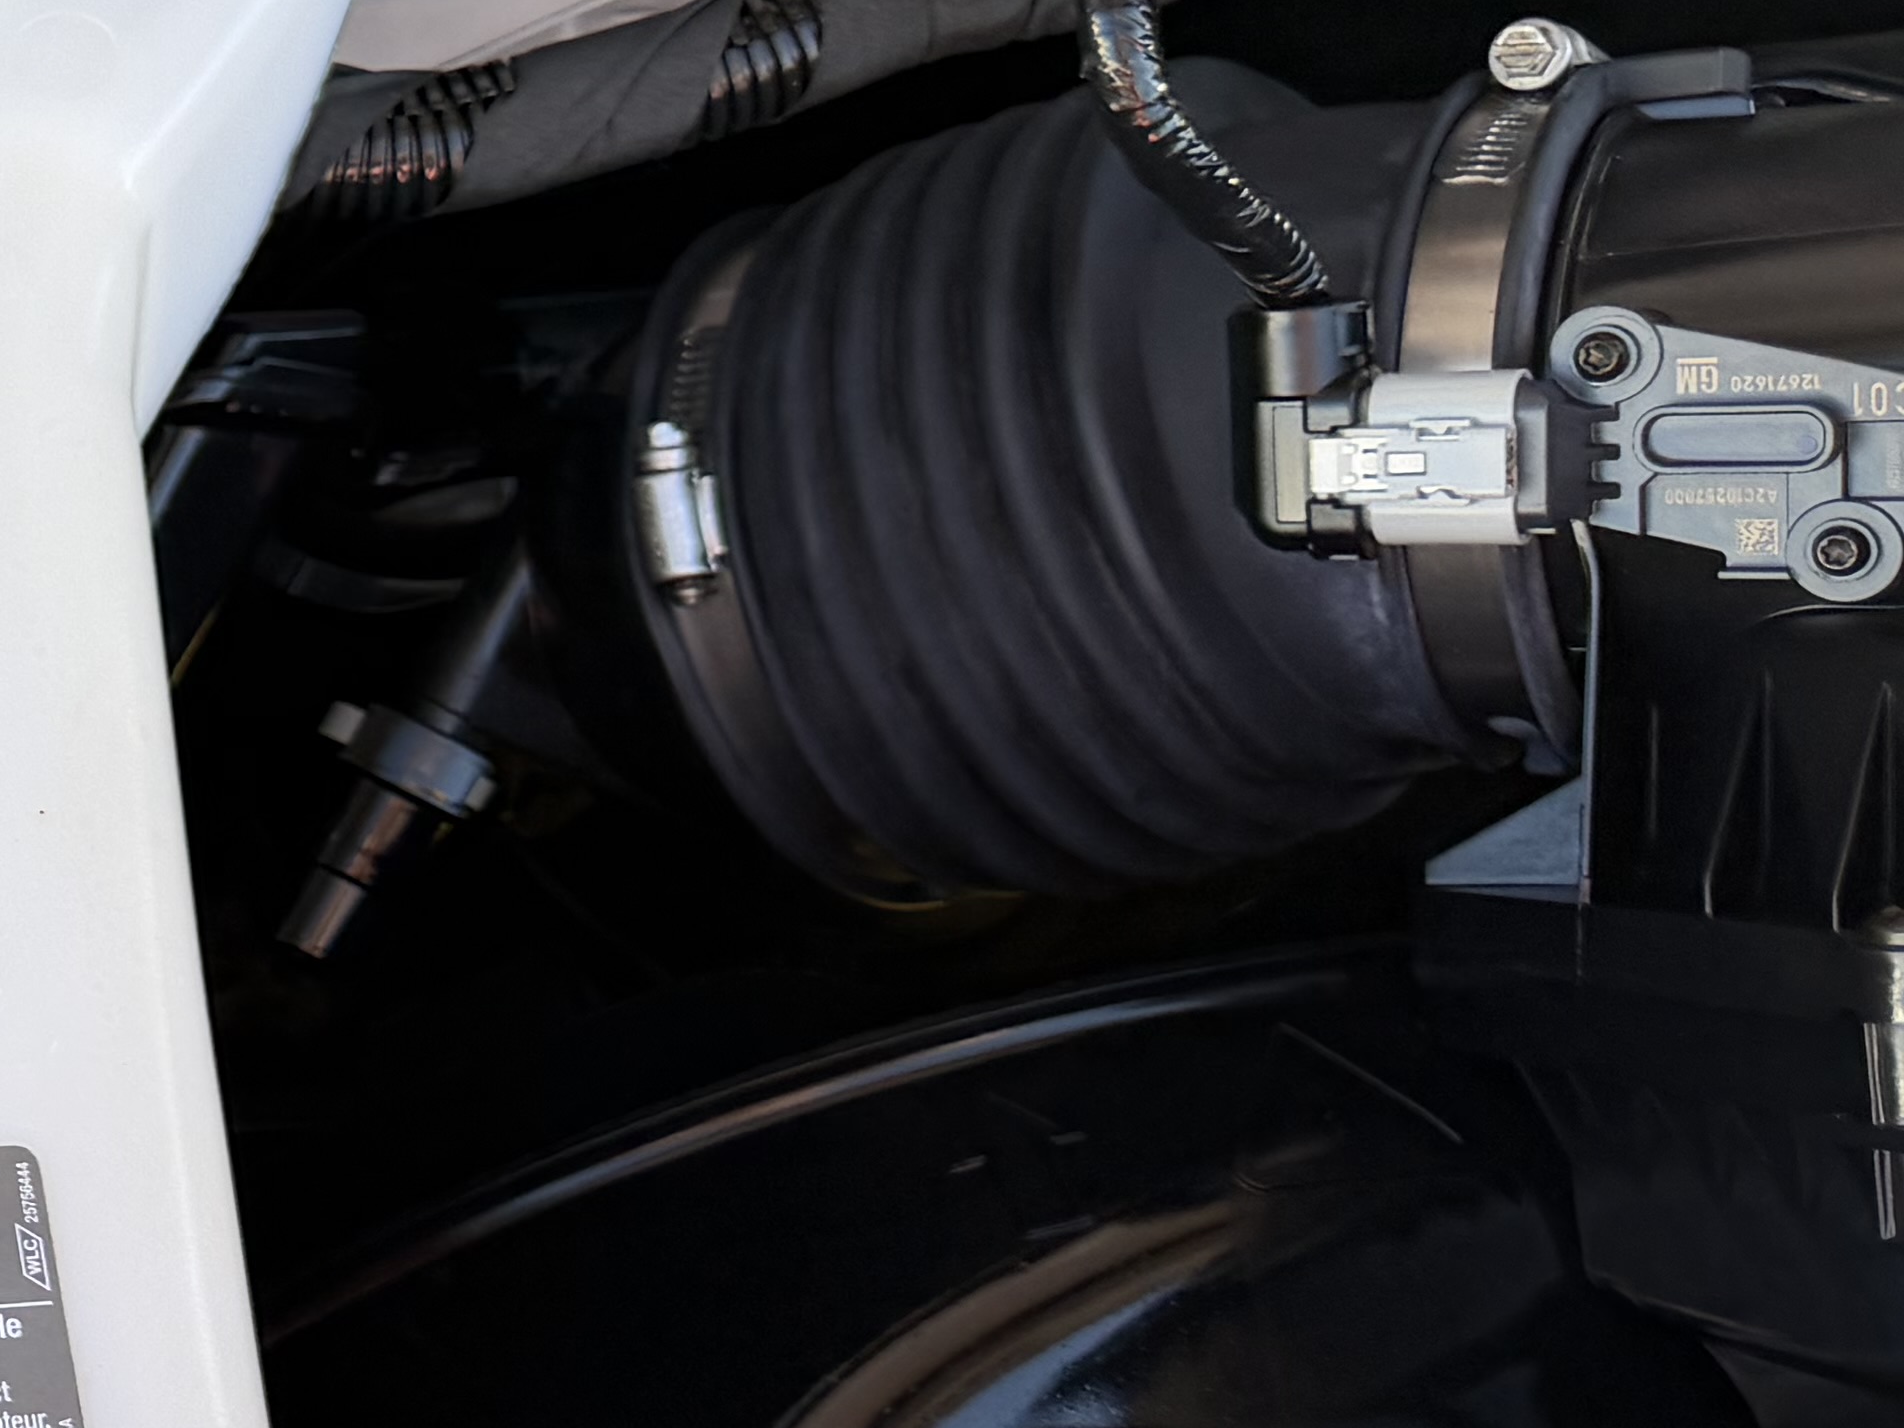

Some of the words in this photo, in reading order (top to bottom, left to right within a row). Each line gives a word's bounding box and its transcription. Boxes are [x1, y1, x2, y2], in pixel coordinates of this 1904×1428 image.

[1676, 364, 1719, 395] GM
[1731, 373, 1822, 393] 12671620
[25, 1238, 44, 1276] WLC
